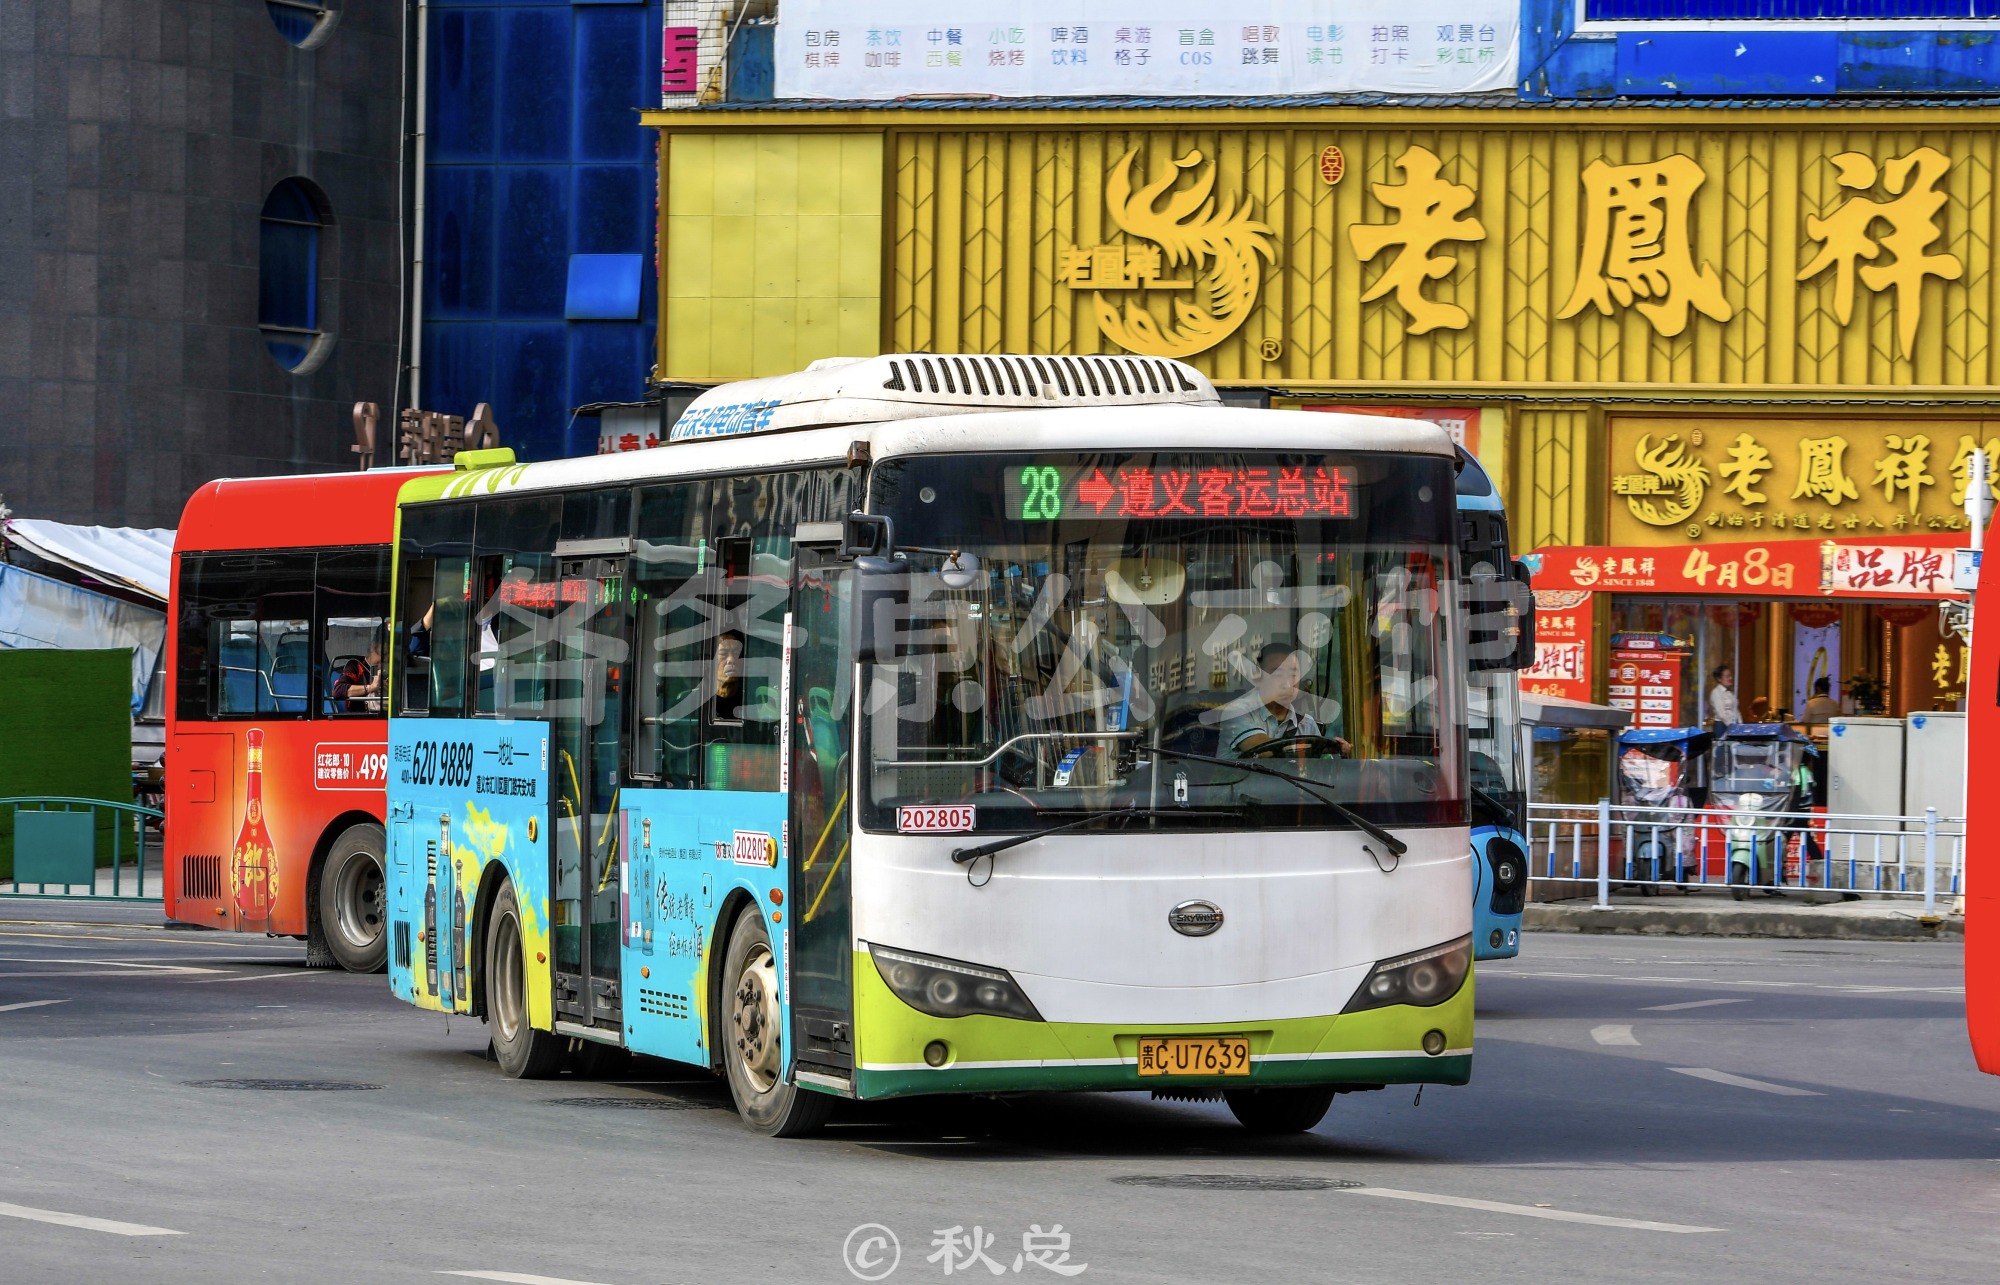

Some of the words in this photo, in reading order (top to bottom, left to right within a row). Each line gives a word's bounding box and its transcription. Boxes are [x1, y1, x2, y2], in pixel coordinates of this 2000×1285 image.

[805, 30, 840, 47] 包房
[865, 29, 901, 46] 茶饮
[927, 28, 962, 46] 中餐
[988, 27, 1024, 44] 小吃
[1051, 27, 1088, 44] 啤酒
[1114, 27, 1151, 44] 桌游
[1178, 28, 1216, 46] 盲盒
[1242, 25, 1280, 43] 唱歌
[1307, 25, 1345, 42] 电影
[1371, 25, 1409, 42] 拍照
[1437, 25, 1496, 42] 观景台
[804, 50, 840, 68] 棋牌
[865, 51, 901, 68] 咖啡
[926, 50, 962, 68] 西餐
[988, 49, 1024, 66] 烧烤
[1051, 48, 1087, 65] 饮料
[1114, 48, 1151, 66] 格子
[1180, 51, 1213, 65] COS
[1242, 47, 1279, 65] 跳舞
[1306, 47, 1344, 64] 读书
[1371, 47, 1409, 64] 打卡
[1437, 47, 1496, 64] 彩虹桥
[1348, 145, 1962, 361] 老鳳祥
[1021, 467, 1060, 519] 28
[1118, 468, 1350, 518] 遵义客运总站
[1682, 547, 1795, 589] 4月8日
[1848, 548, 1957, 592] 品牌
[1602, 578, 1634, 587] SINCE
[413, 741, 436, 785] 620
[439, 742, 474, 787] 9889
[499, 737, 513, 765] 地址
[317, 768, 350, 780] 建议零售价
[901, 809, 972, 829] 202805
[736, 836, 768, 862] 202805
